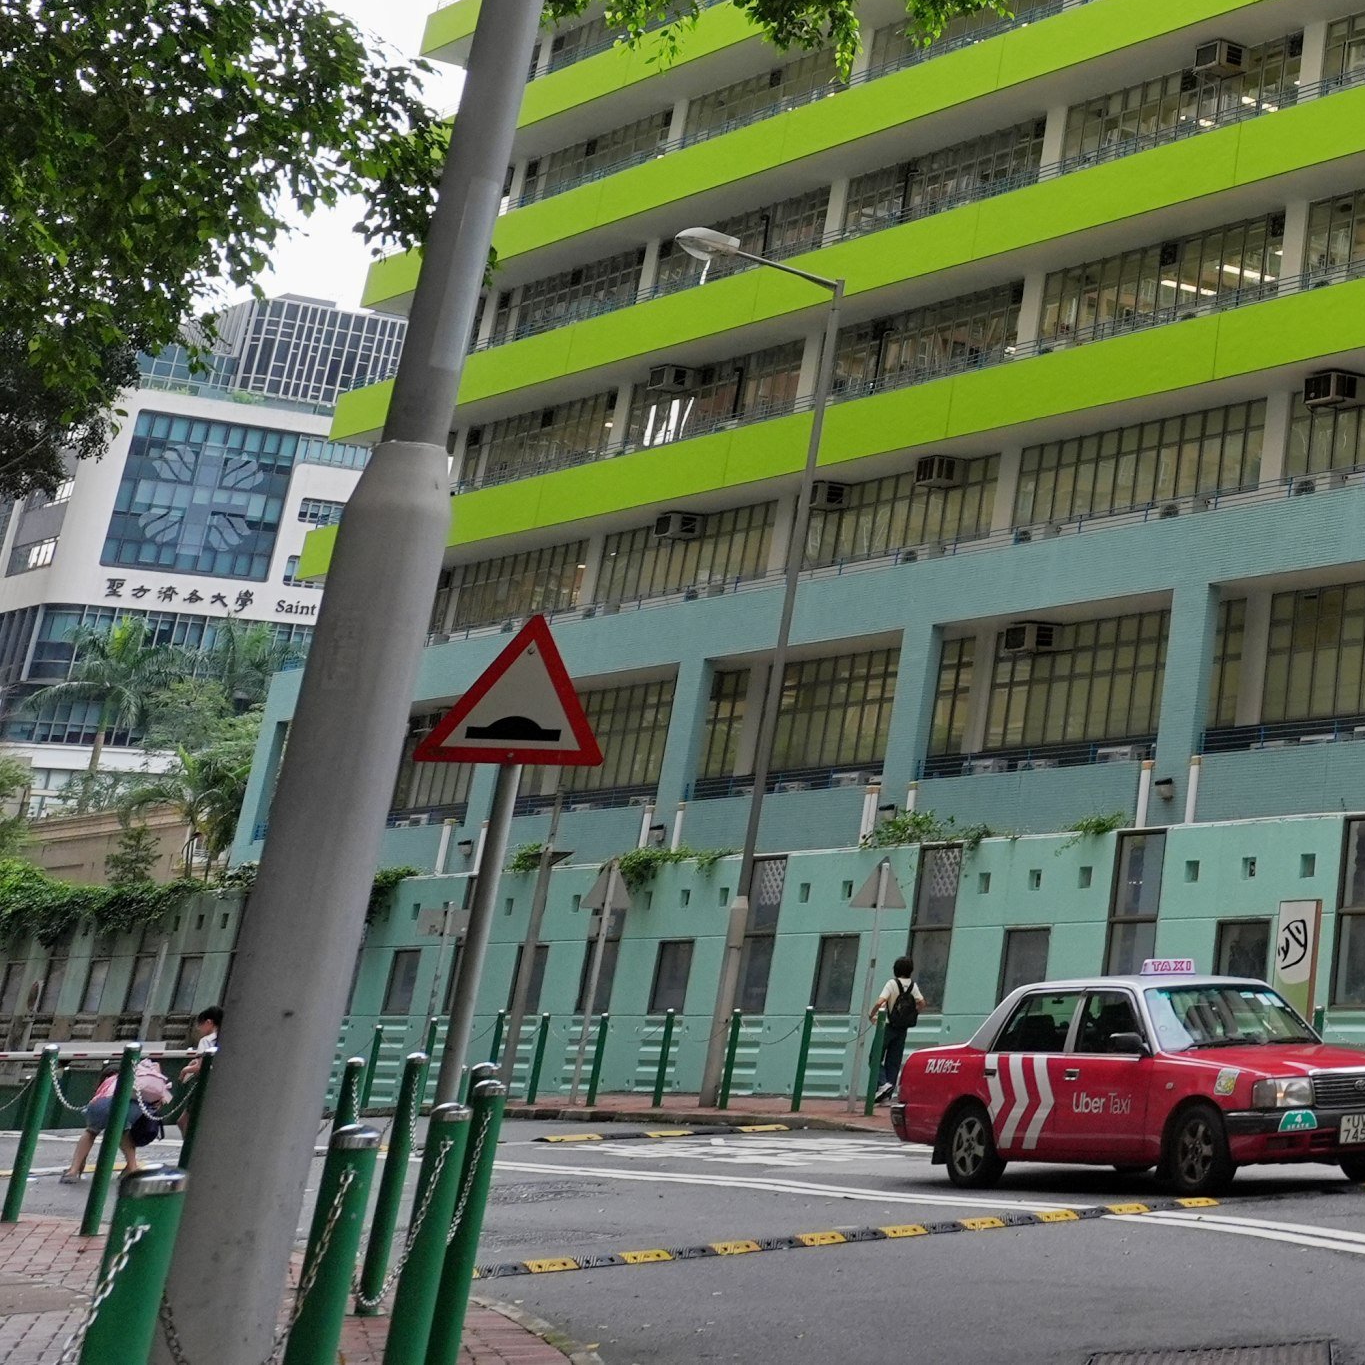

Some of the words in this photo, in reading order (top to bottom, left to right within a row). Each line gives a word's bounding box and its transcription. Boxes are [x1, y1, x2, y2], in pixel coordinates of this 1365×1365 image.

[104, 577, 254, 614] 聖方濟各大學
[274, 598, 318, 617] Saint
[1151, 960, 1193, 972] TAXI
[1072, 1091, 1106, 1114] Uber
[1107, 1091, 1132, 1115] Taxi
[1295, 1114, 1302, 1123] 4
